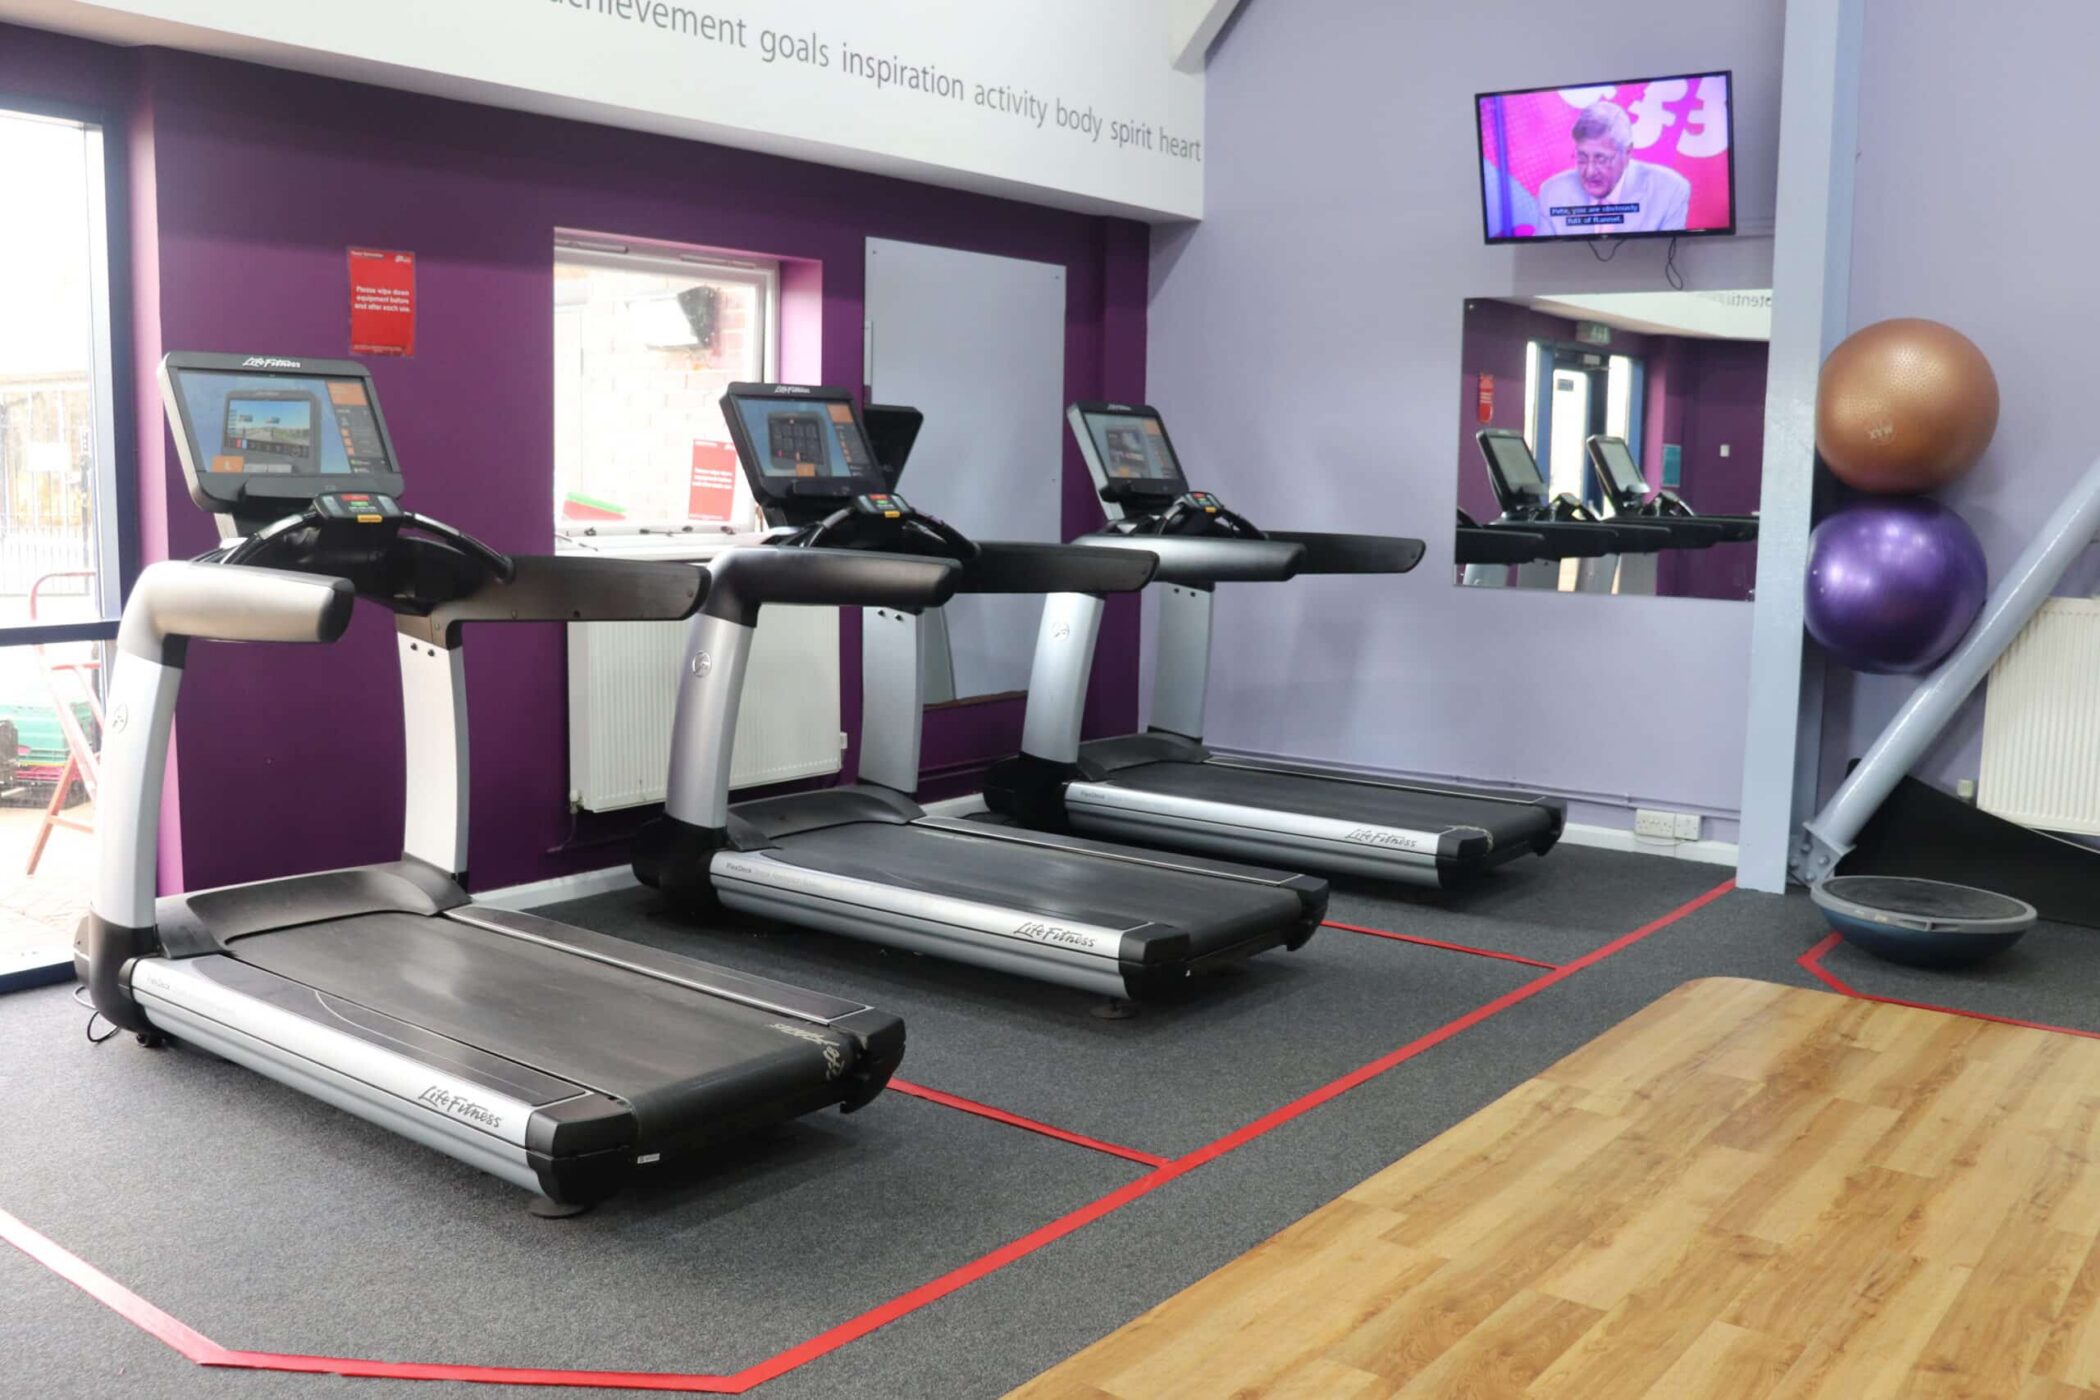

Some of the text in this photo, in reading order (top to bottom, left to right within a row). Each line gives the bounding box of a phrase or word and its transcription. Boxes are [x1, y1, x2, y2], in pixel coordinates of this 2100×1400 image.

[551, 0, 1201, 162] evement goals inspiration activity body spirit heart
[1013, 921, 1096, 948] Life Fitness
[417, 1085, 503, 1128] Life Fitness
